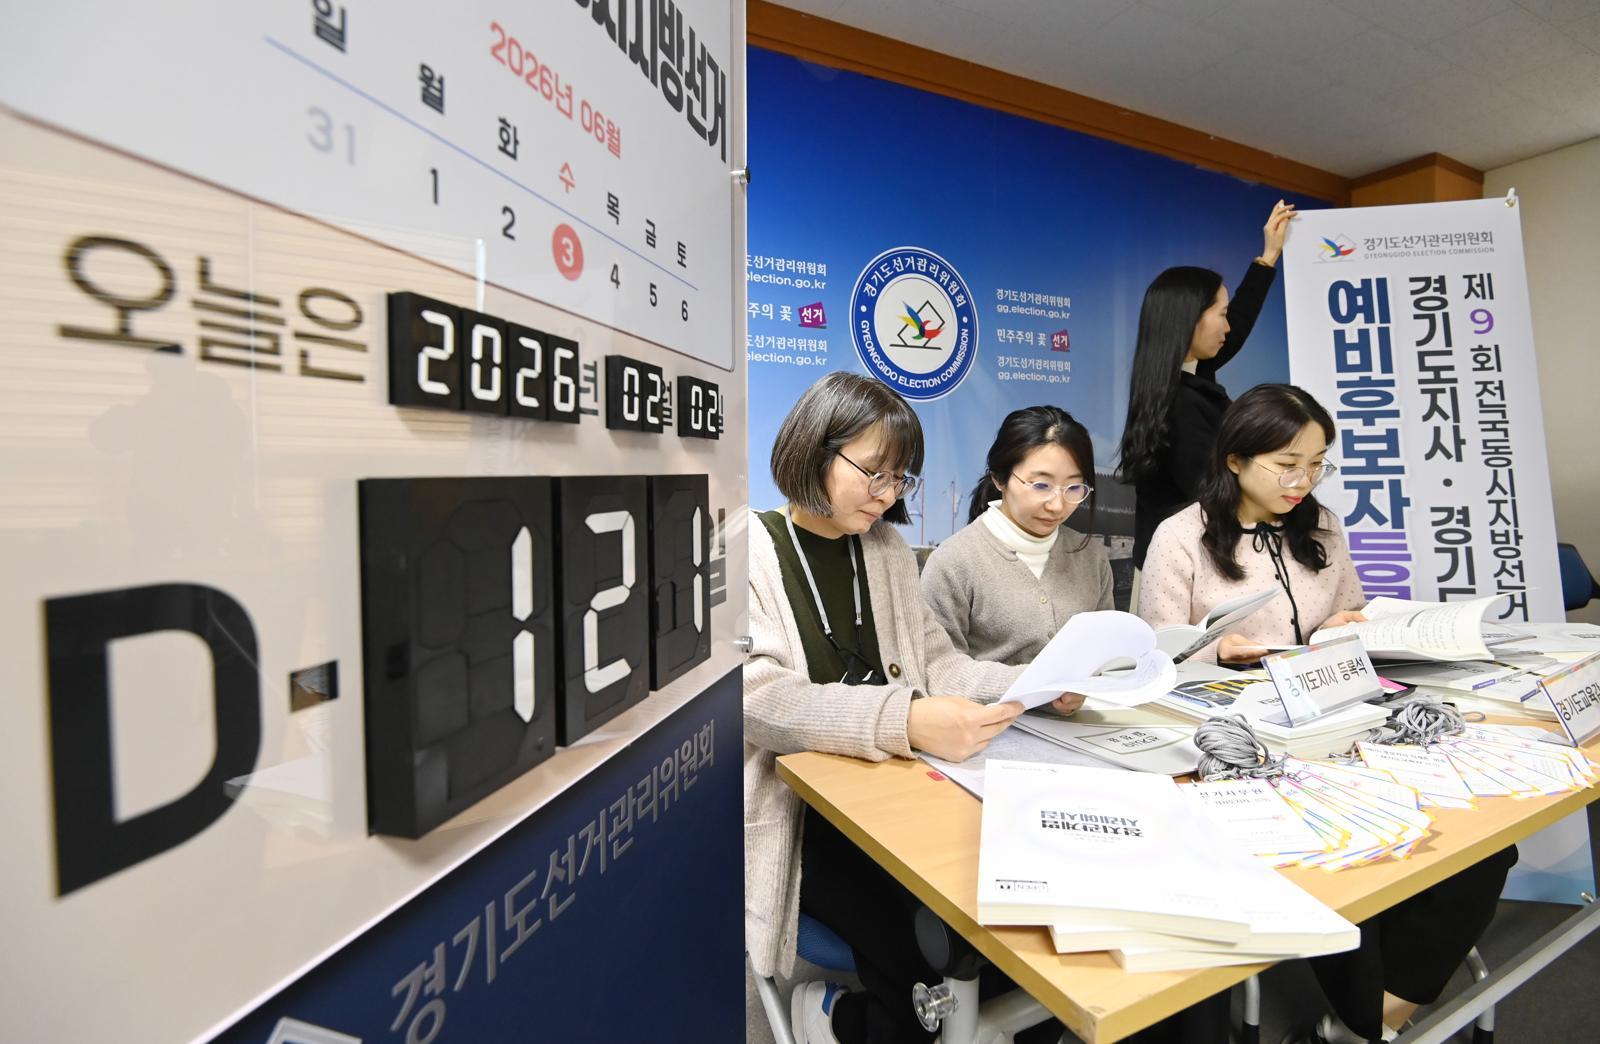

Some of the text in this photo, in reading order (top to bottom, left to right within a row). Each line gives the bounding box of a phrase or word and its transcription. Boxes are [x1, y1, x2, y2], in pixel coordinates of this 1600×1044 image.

[490, 21, 621, 159] 2026년 06월
[313, 0, 687, 268] 일 월 화 수 목 금 토
[307, 105, 689, 322] 31 1 2 3 4 5 6
[1363, 231, 1494, 251] 경기도선거관리위원회
[1364, 247, 1495, 260] GYEONGGIDO ELECTION COMMISSION
[863, 256, 967, 308] 경기도선거관리위원회
[57, 233, 368, 383] 오늘은
[996, 288, 1071, 308] 경기도선거관리위원회
[779, 305, 793, 321] 꽃
[801, 307, 823, 323] 선거
[996, 304, 1071, 319] gg.election.go.kr
[996, 328, 1068, 347] 민주주의 꽃 선거
[861, 320, 969, 389] GYEONGGIDO ELECTION COMMISSION
[997, 355, 1071, 373] 경기도선거관리위원회
[998, 371, 1071, 384] gg.election.go.kr
[1328, 277, 1412, 600] 예비후보자등
[1337, 656, 1368, 681] 등록석
[390, 719, 716, 1044] 경기도선거관리위원회
